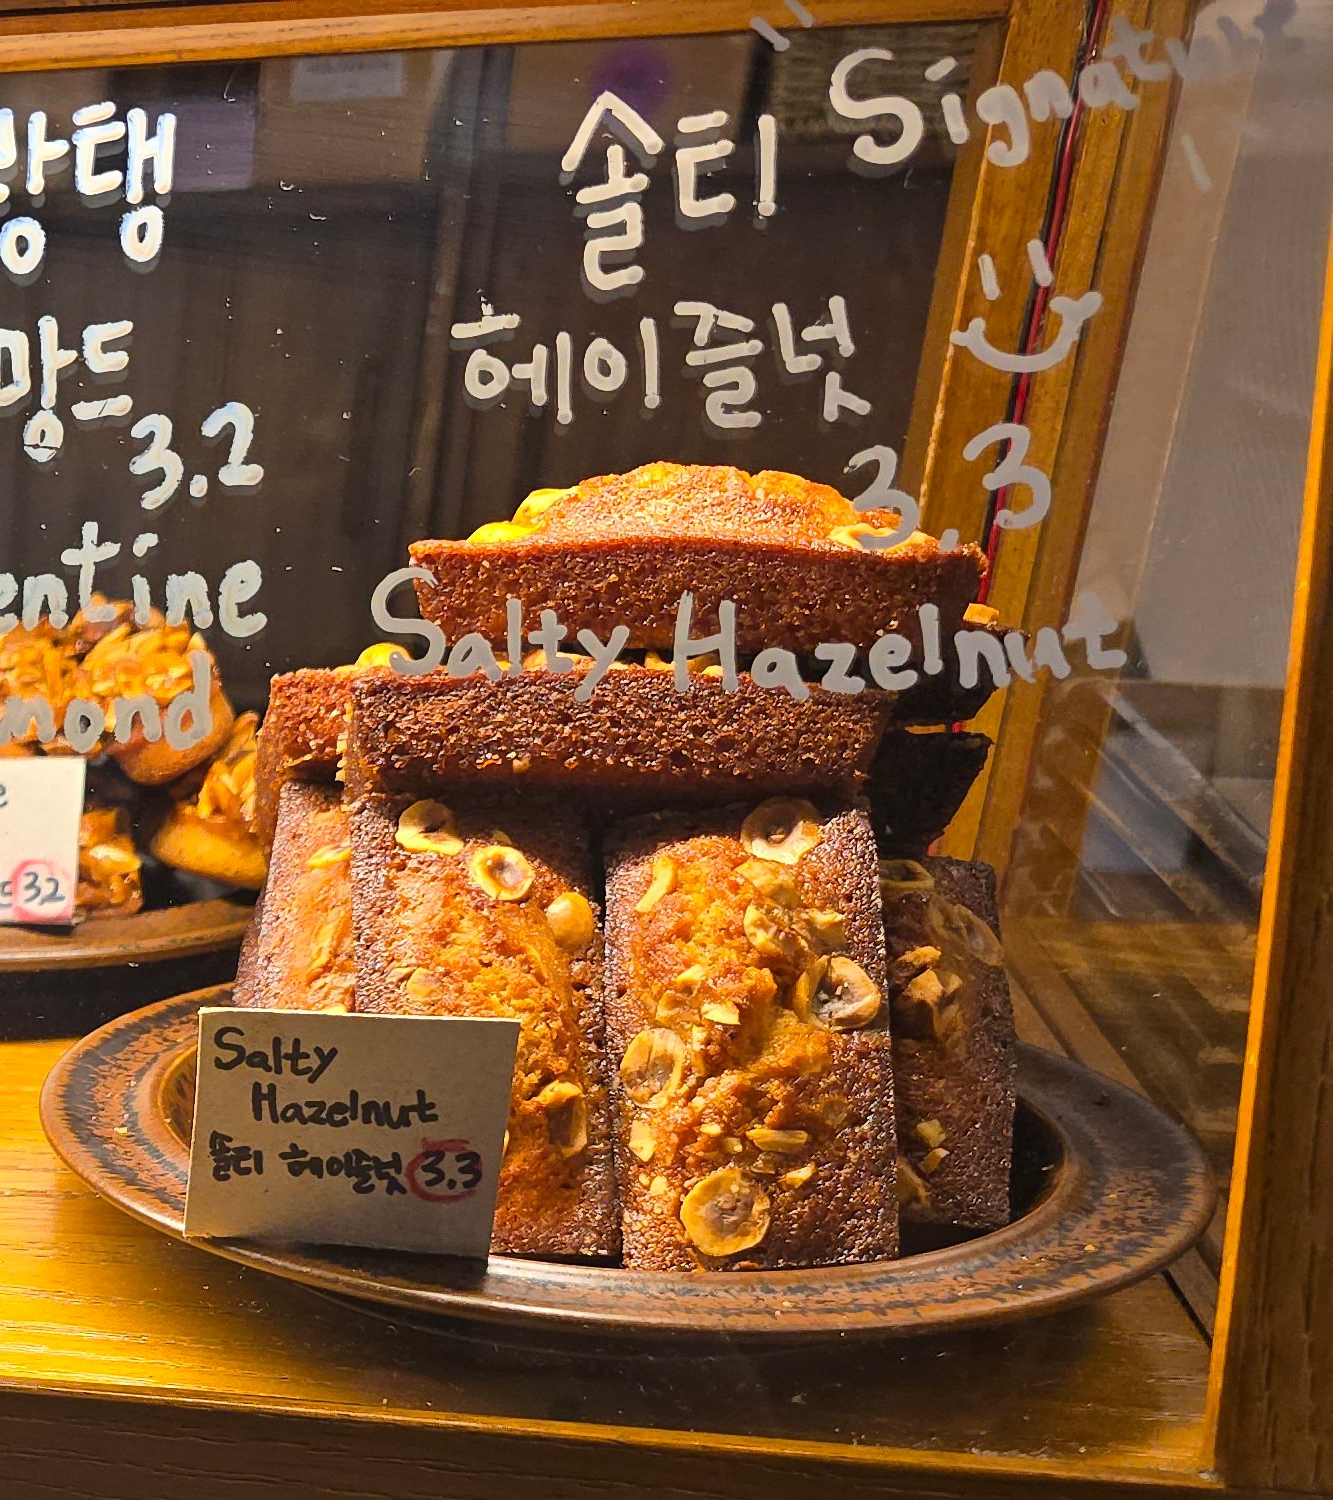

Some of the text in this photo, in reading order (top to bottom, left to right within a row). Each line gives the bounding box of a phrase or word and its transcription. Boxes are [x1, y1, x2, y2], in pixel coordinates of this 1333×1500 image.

[561, 89, 779, 291] 솔티
[450, 294, 873, 429] 헤이즐넛
[128, 401, 265, 511] 3.2
[844, 421, 1054, 554] 3.3
[370, 566, 1129, 704] Salty Hazelnut
[213, 1026, 339, 1084] Salty
[251, 1081, 439, 1130] Hazelnut
[420, 1150, 483, 1190] 3.3
